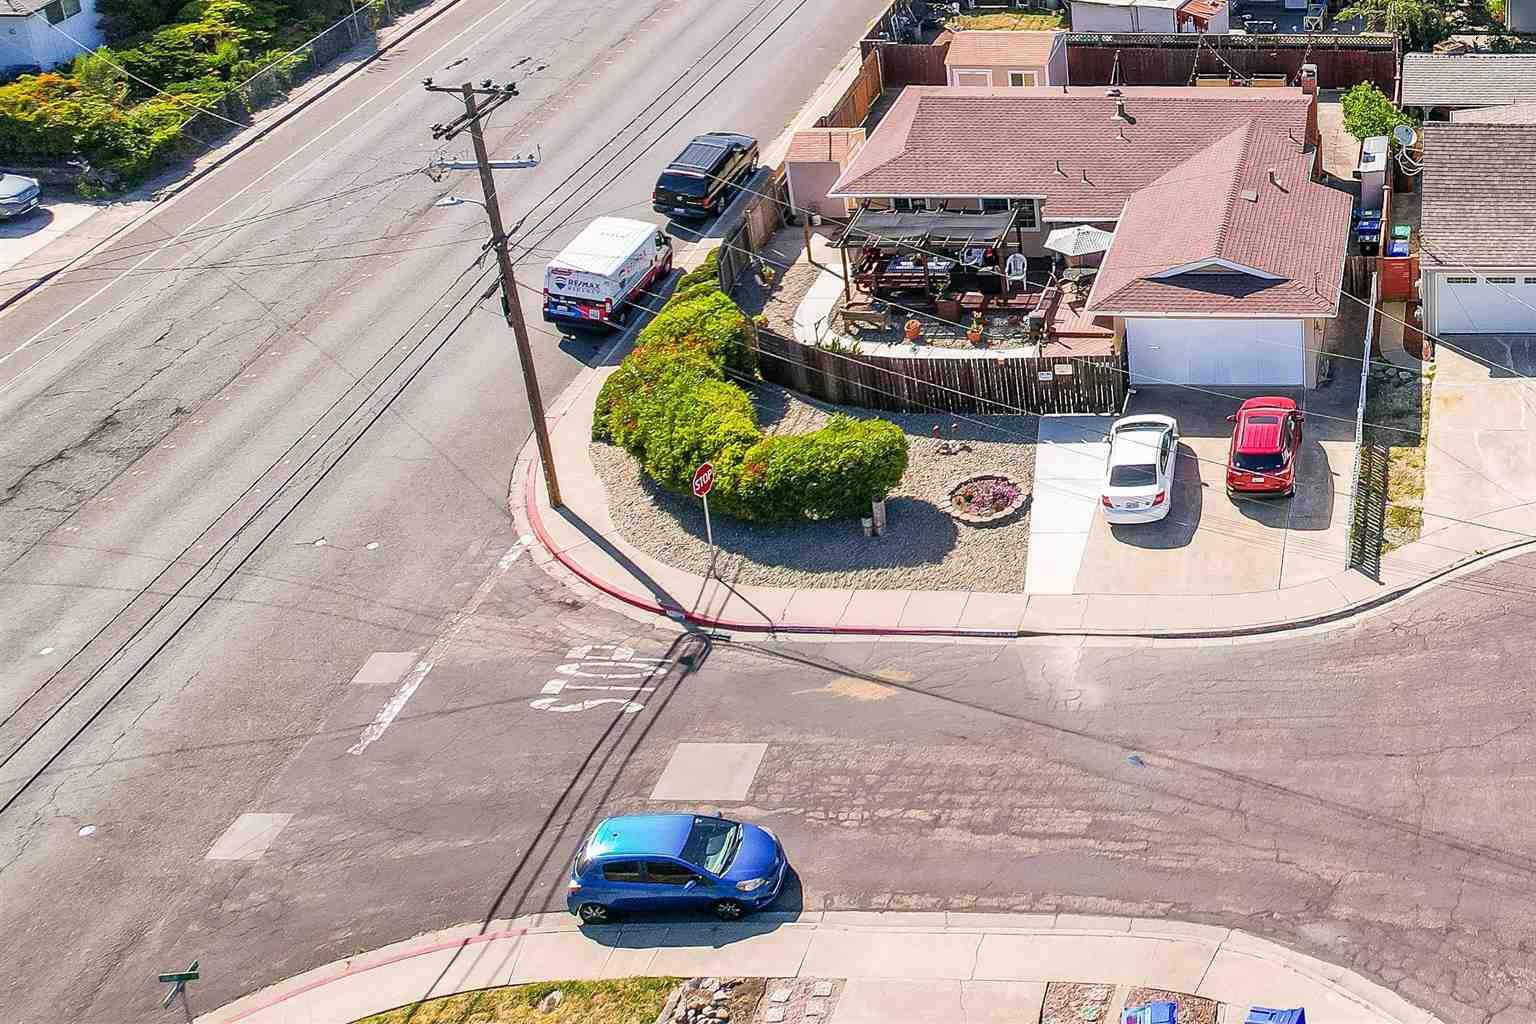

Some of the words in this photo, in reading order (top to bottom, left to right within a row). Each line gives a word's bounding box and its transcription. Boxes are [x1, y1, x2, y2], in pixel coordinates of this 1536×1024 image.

[567, 278, 601, 289] RE/MAX
[694, 468, 713, 491] STOP
[529, 645, 673, 713] STOP
